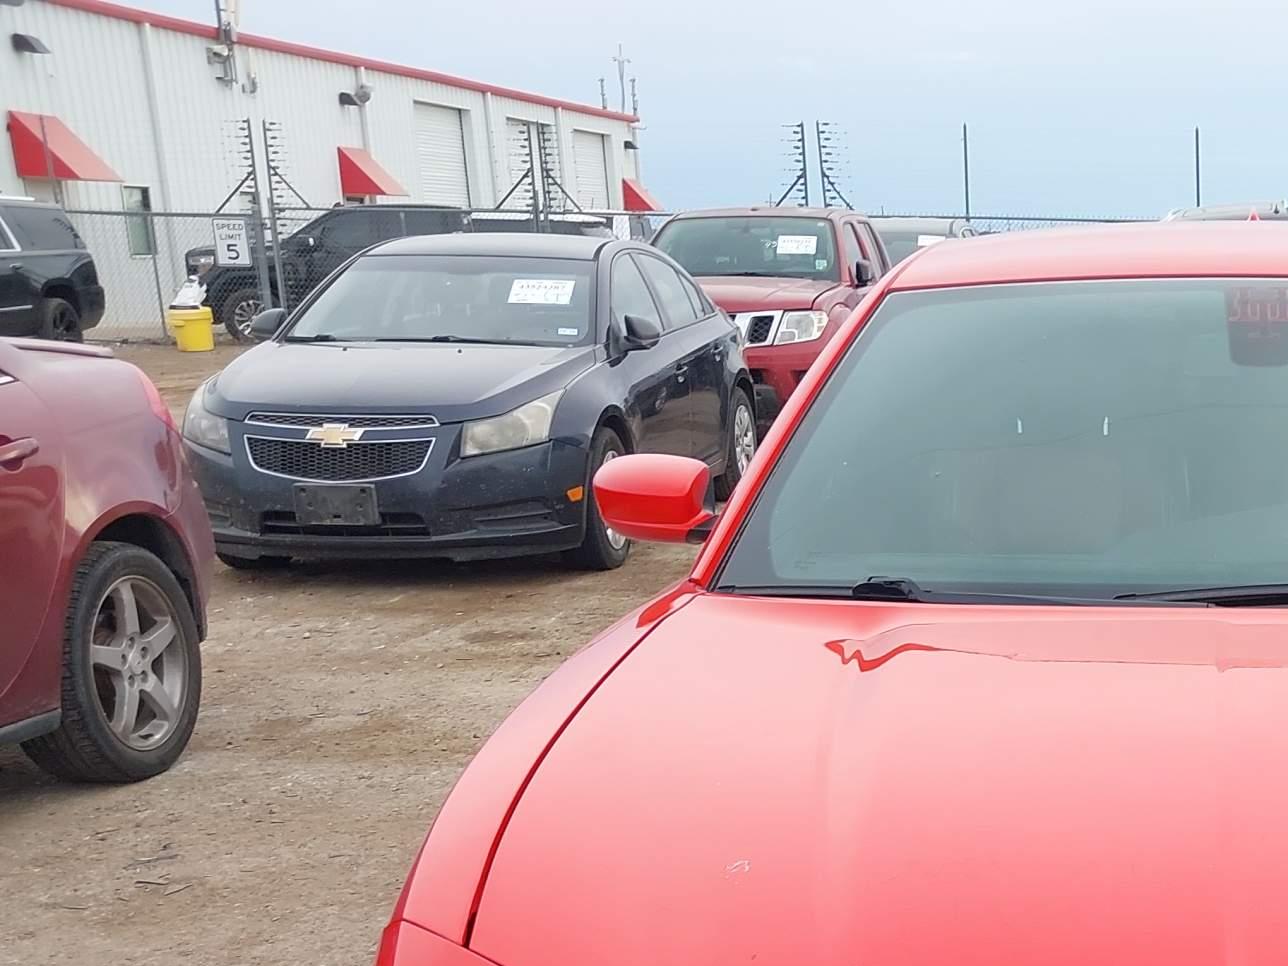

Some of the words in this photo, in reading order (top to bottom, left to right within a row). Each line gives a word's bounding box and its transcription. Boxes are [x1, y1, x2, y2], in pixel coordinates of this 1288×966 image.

[216, 223, 243, 231] SPEED
[220, 233, 241, 241] LIMIT
[227, 244, 240, 260] 5
